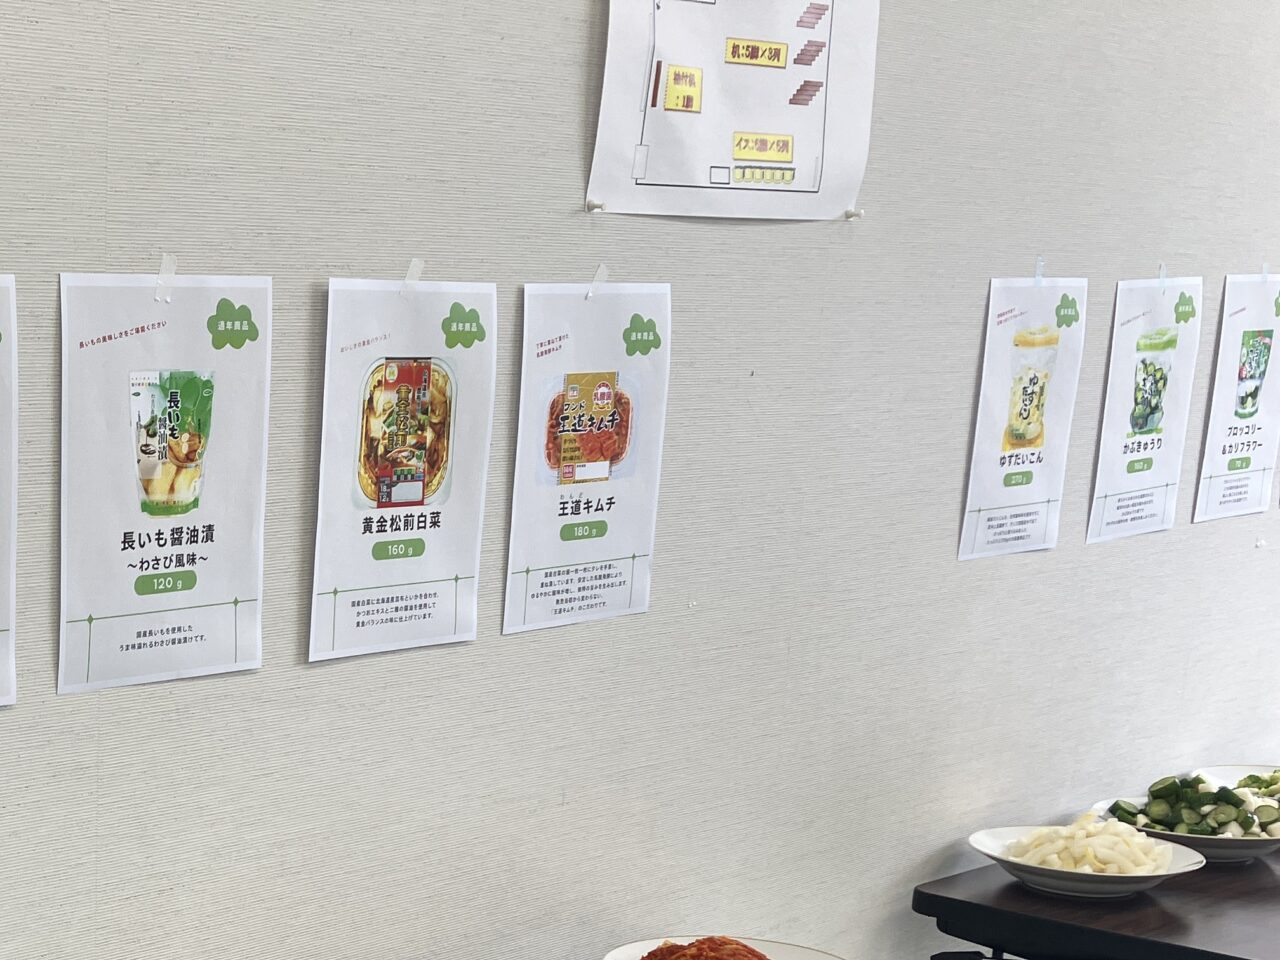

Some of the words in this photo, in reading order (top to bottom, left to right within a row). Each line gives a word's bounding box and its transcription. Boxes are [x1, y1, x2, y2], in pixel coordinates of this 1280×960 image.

[167, 391, 180, 440] 長いも
[559, 410, 619, 434] 王道キムチ
[1227, 424, 1263, 438] ブロッコリー
[1123, 438, 1163, 455] かぶきゅうり
[999, 451, 1044, 468] ゆずだいこん
[558, 496, 616, 517] 王道キムチ
[362, 511, 442, 535] 黄金松前白菜
[574, 526, 590, 537] 180
[591, 528, 597, 537] g
[120, 524, 215, 552] 長いも醤油漬
[388, 544, 405, 556] 160
[407, 547, 413, 556] g
[153, 577, 173, 590] 120
[176, 580, 182, 590] g
[136, 625, 193, 639] 国産長いもを使用した
